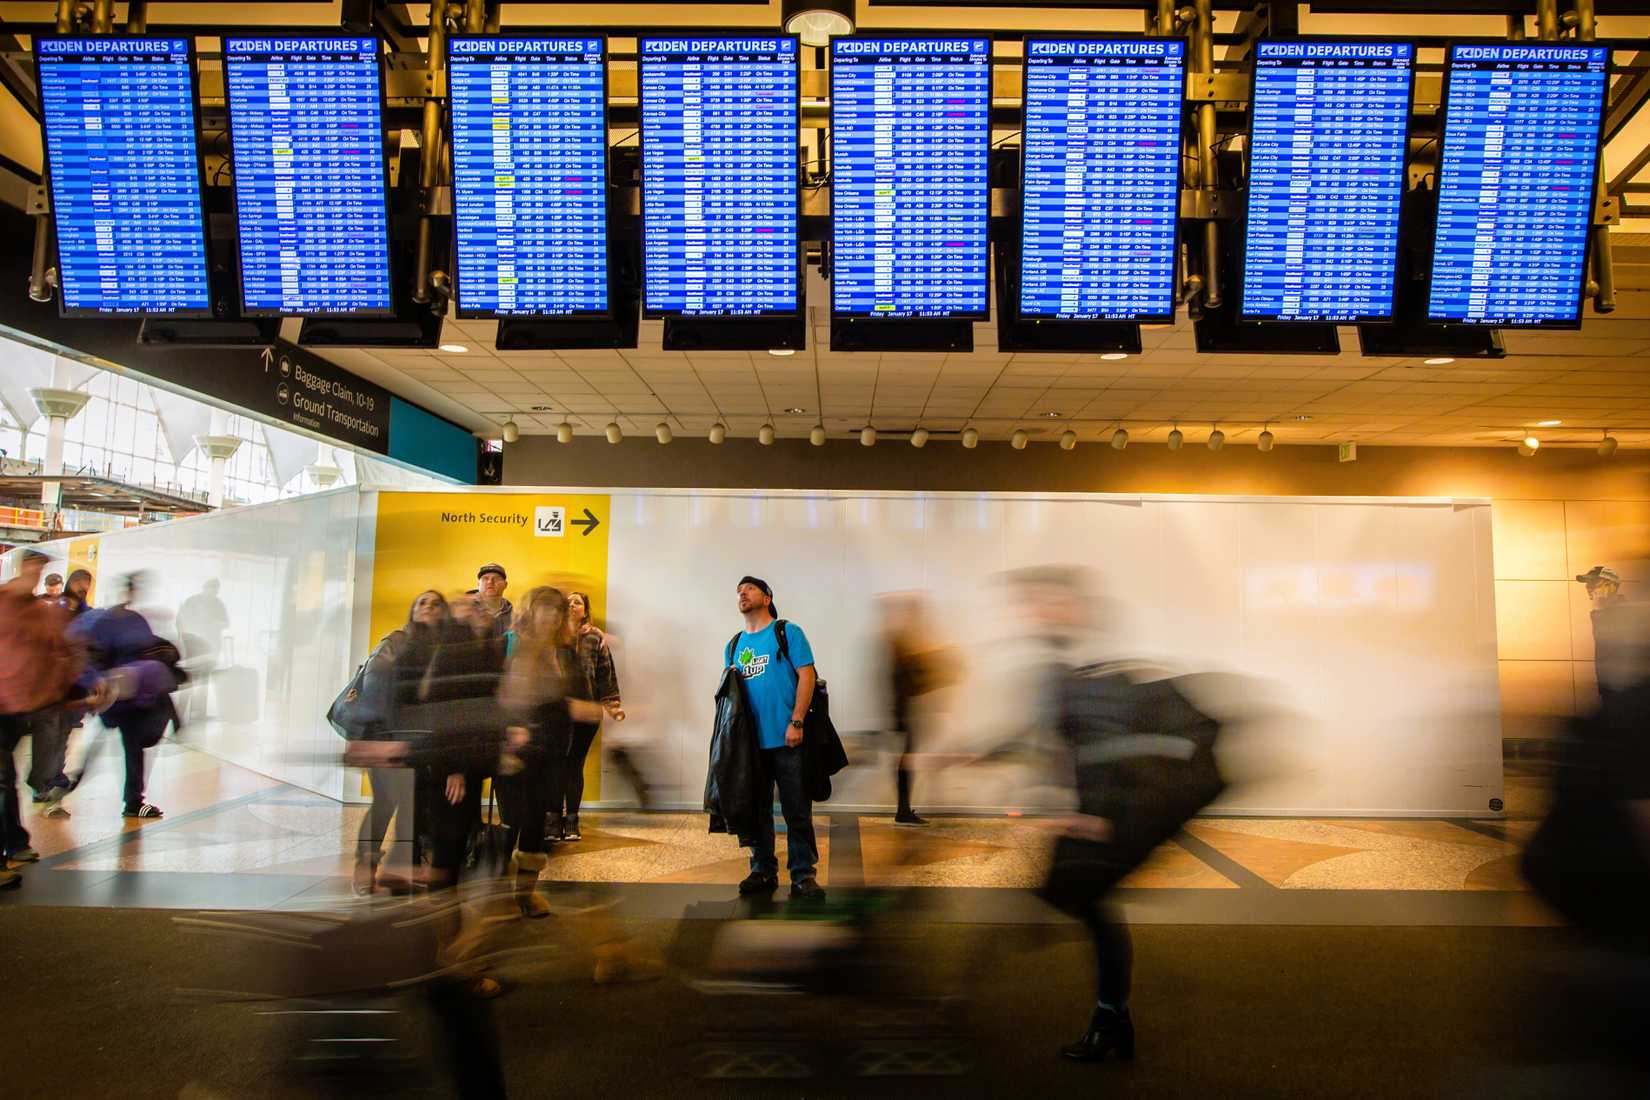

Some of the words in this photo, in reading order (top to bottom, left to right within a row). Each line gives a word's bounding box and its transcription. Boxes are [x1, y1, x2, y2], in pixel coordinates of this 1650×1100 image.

[59, 41, 82, 51] DEN
[87, 41, 168, 51] DEPARTURES
[247, 41, 270, 51] DEN
[275, 41, 357, 51] DEPARTURES
[471, 41, 495, 51] DEN
[499, 41, 582, 51] DEPARTURES
[663, 41, 687, 51] DEN
[692, 41, 776, 51] DEPARTURES
[855, 42, 880, 52] DEN
[884, 42, 968, 52] DEPARTURES
[1050, 44, 1075, 54] DEN
[1079, 44, 1164, 54] DEPARTURES
[1279, 46, 1304, 56] DEN
[1308, 46, 1392, 56] DEPARTURES
[1474, 48, 1499, 59] DEN
[1503, 48, 1588, 59] DEPARTURES
[295, 365, 330, 394] Baggage
[356, 392, 374, 411] 10-19
[293, 392, 325, 416] Ground
[327, 404, 379, 437] Transportation
[293, 412, 320, 428] Information
[441, 512, 475, 522] North
[480, 513, 528, 527] Security
